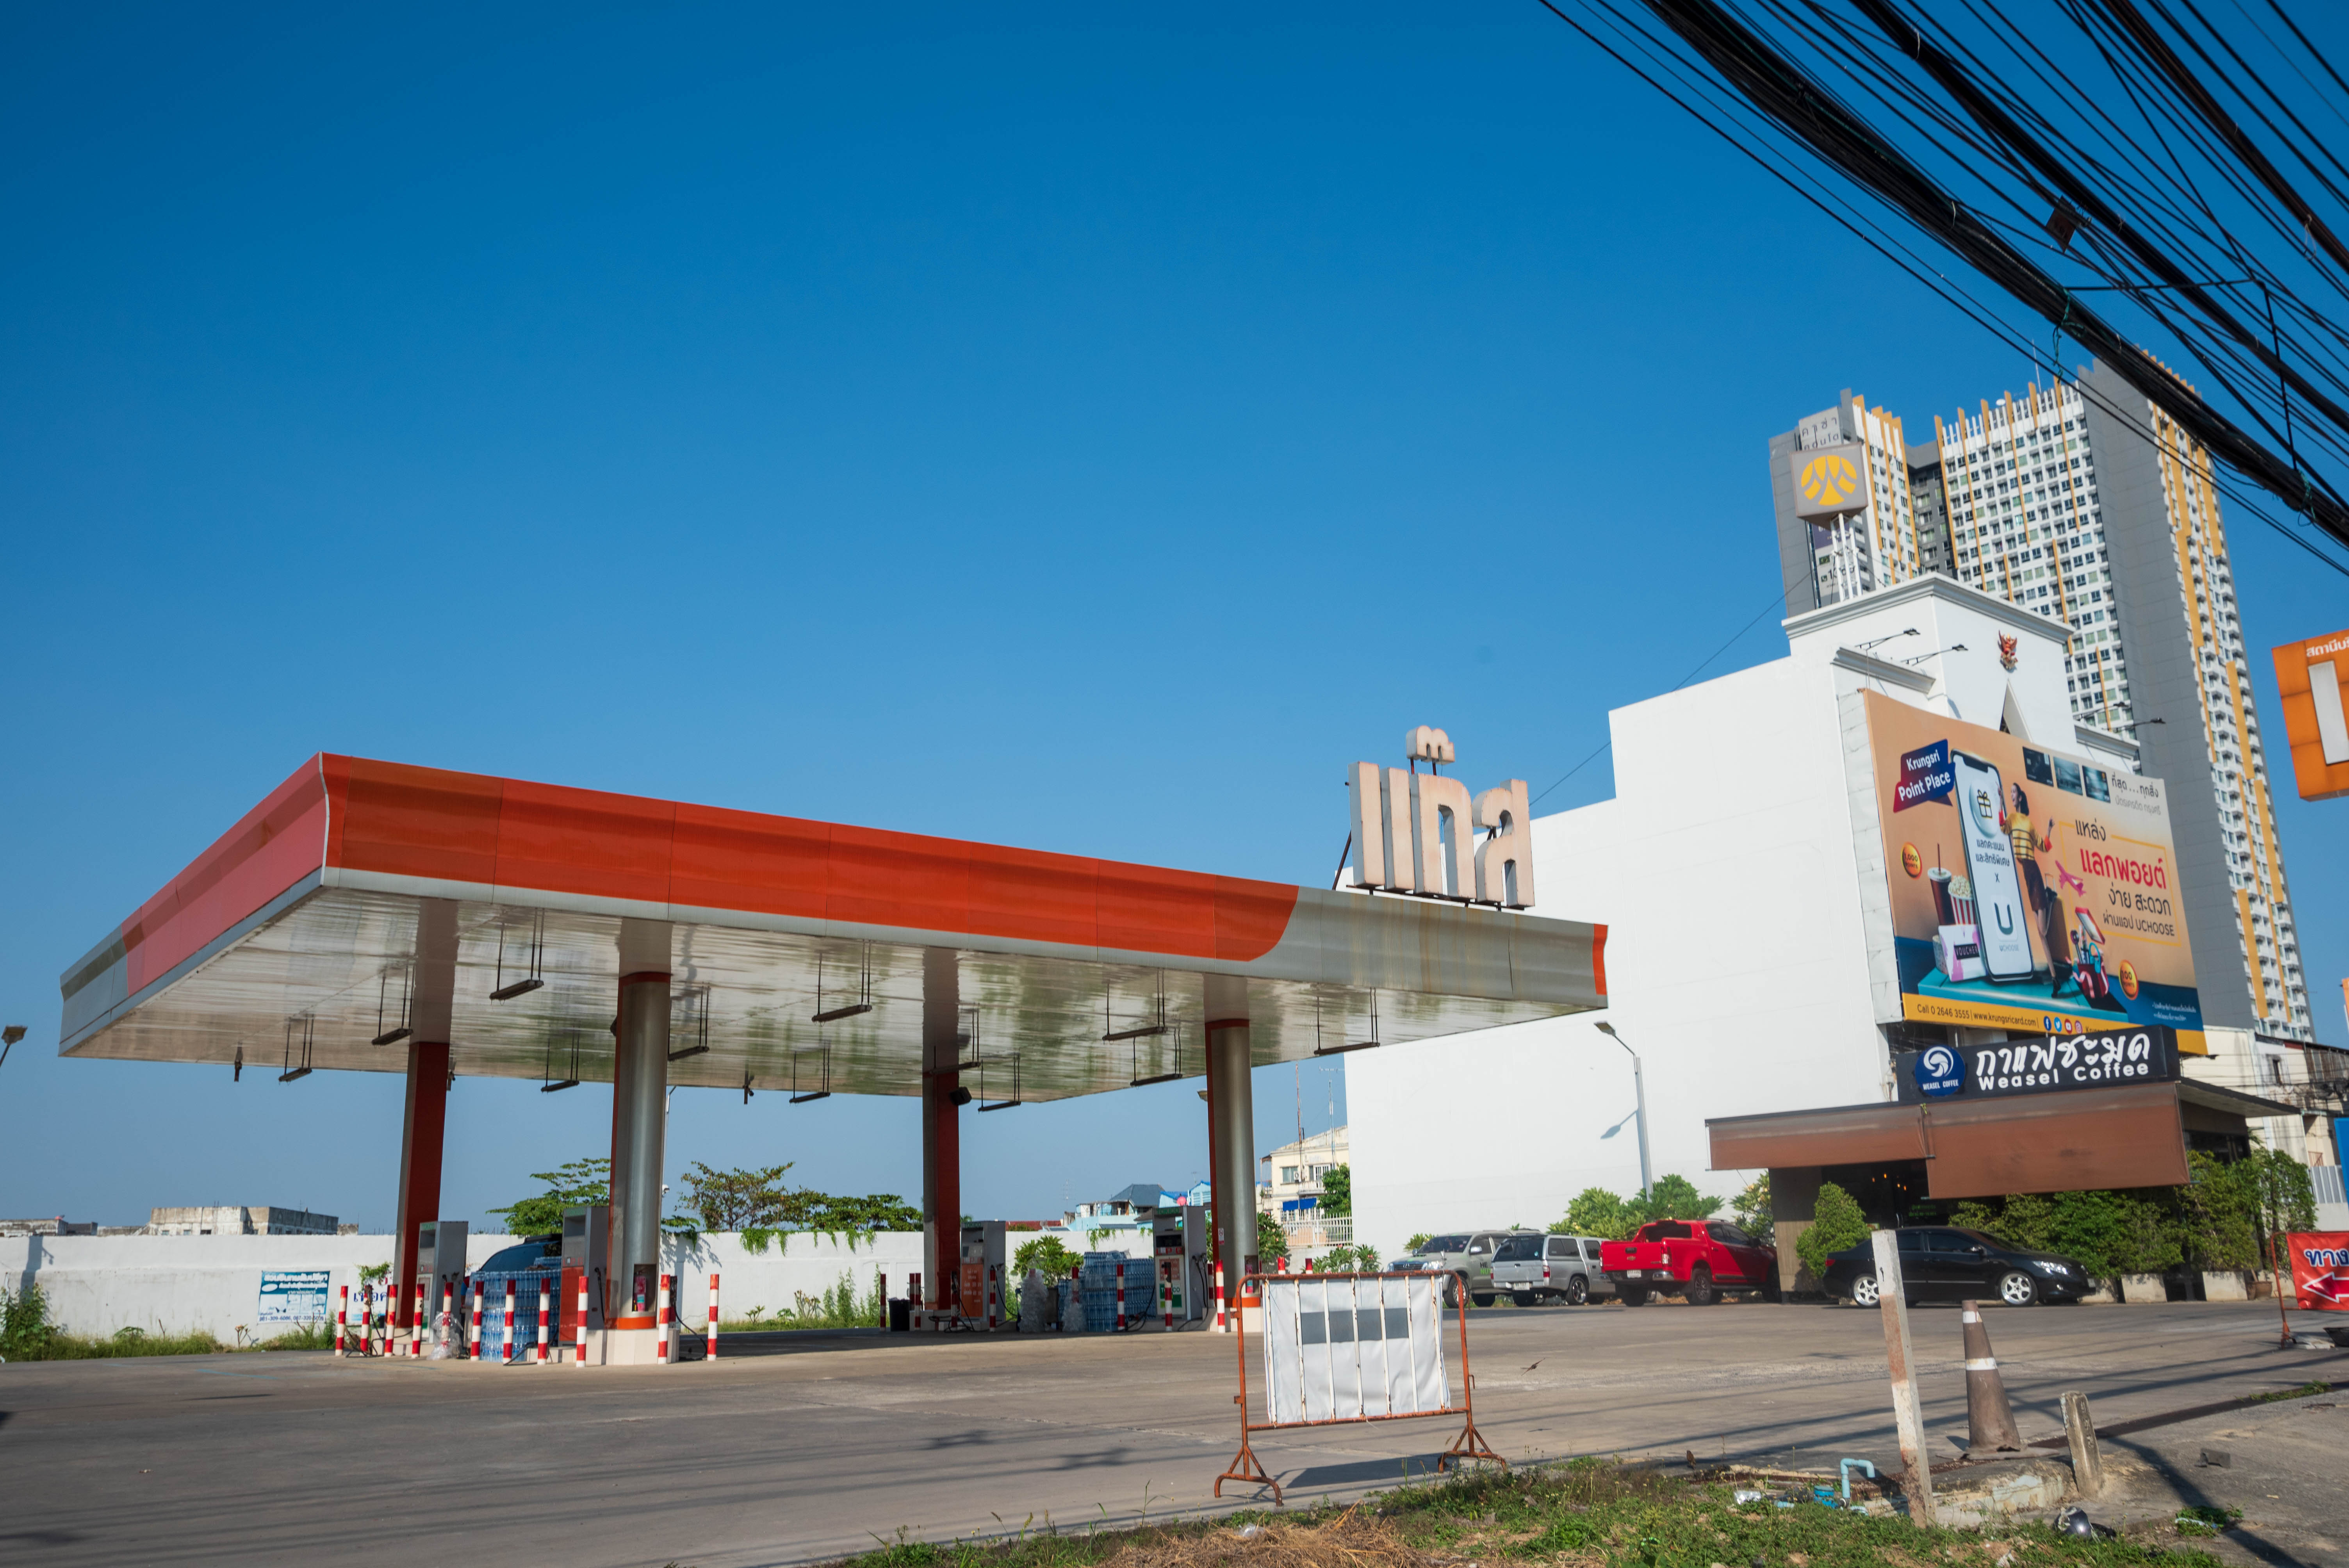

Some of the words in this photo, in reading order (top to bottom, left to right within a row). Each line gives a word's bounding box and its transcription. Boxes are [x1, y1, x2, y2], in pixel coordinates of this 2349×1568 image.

[1906, 749, 1940, 772] Krungsri
[1898, 780, 1925, 802] Point
[1925, 772, 1951, 791] Place
[2075, 818, 2106, 841] แหล่ง
[1977, 839, 2005, 852] แลกคะแนน
[2080, 848, 2166, 889] แลกพอยต์
[2108, 881, 2132, 909] ง่าย
[2135, 894, 2171, 916] สะดวก
[2103, 909, 2134, 930] ผ่านแอป
[2135, 919, 2175, 936] UCHOOSE
[1955, 945, 1978, 956] VOUCHER
[2121, 969, 2132, 980] 100
[1917, 1003, 1930, 1014] Call
[1930, 1006, 1936, 1015] 0
[1937, 1007, 1953, 1017] 2646
[1955, 1009, 1970, 1019] 3555
[1973, 1012, 2037, 1026] www.krungsricard.com
[1976, 1033, 2150, 1076] กาแฟชะมด
[1923, 1082, 1941, 1090] WEASEL
[1943, 1079, 1959, 1088] COFFEE
[1978, 1068, 2059, 1090] Weasel
[2073, 1062, 2149, 1082] Coffee
